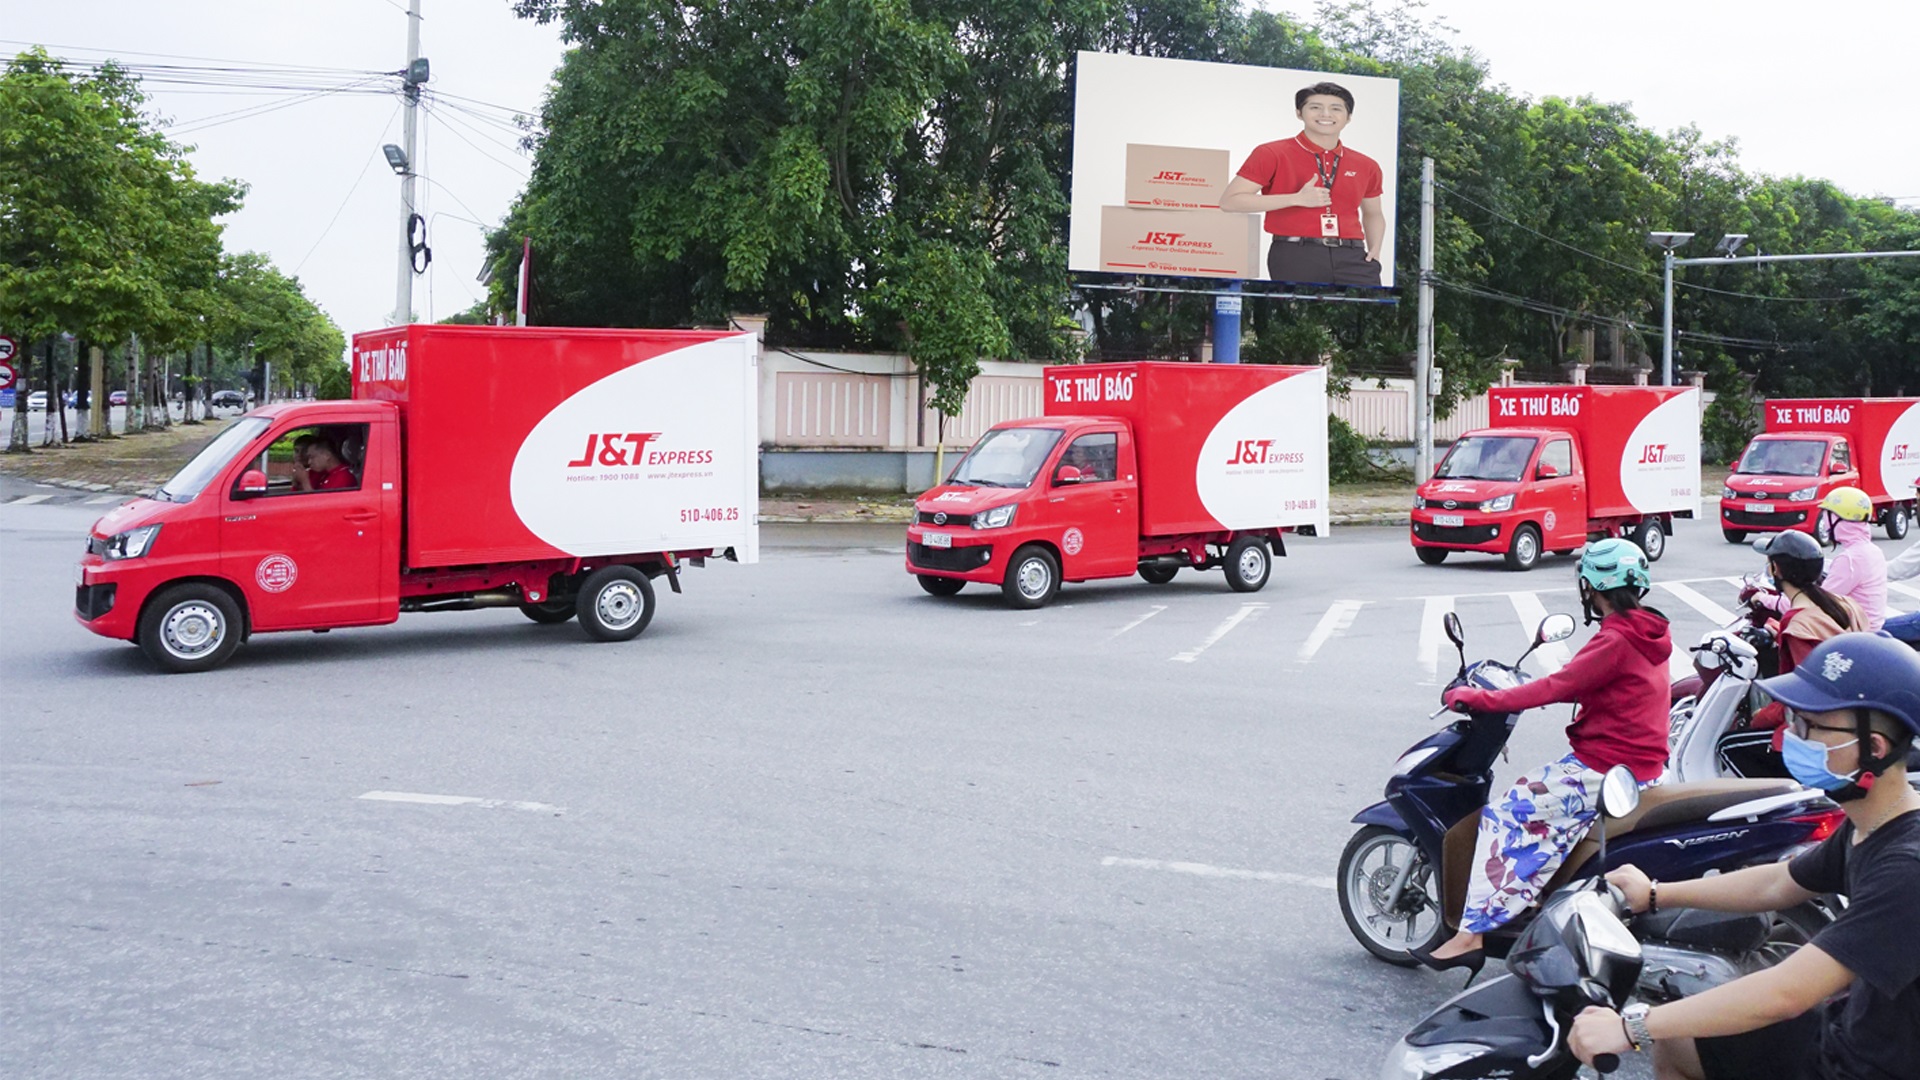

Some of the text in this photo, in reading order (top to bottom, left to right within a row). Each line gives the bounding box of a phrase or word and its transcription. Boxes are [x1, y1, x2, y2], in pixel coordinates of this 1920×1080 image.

[1153, 171, 1187, 181] J&T
[1138, 232, 1213, 249] J&T EXPRESS
[1075, 372, 1102, 402] THƯ
[1520, 393, 1550, 416] THƯ
[1795, 405, 1822, 424] THƯ
[567, 432, 713, 467] J&T EXPRESS
[1226, 439, 1304, 465] J&T EXPRESS
[1638, 444, 1669, 464] J&T
[566, 473, 598, 482] Hotline:
[1663, 829, 1750, 850] VISION
